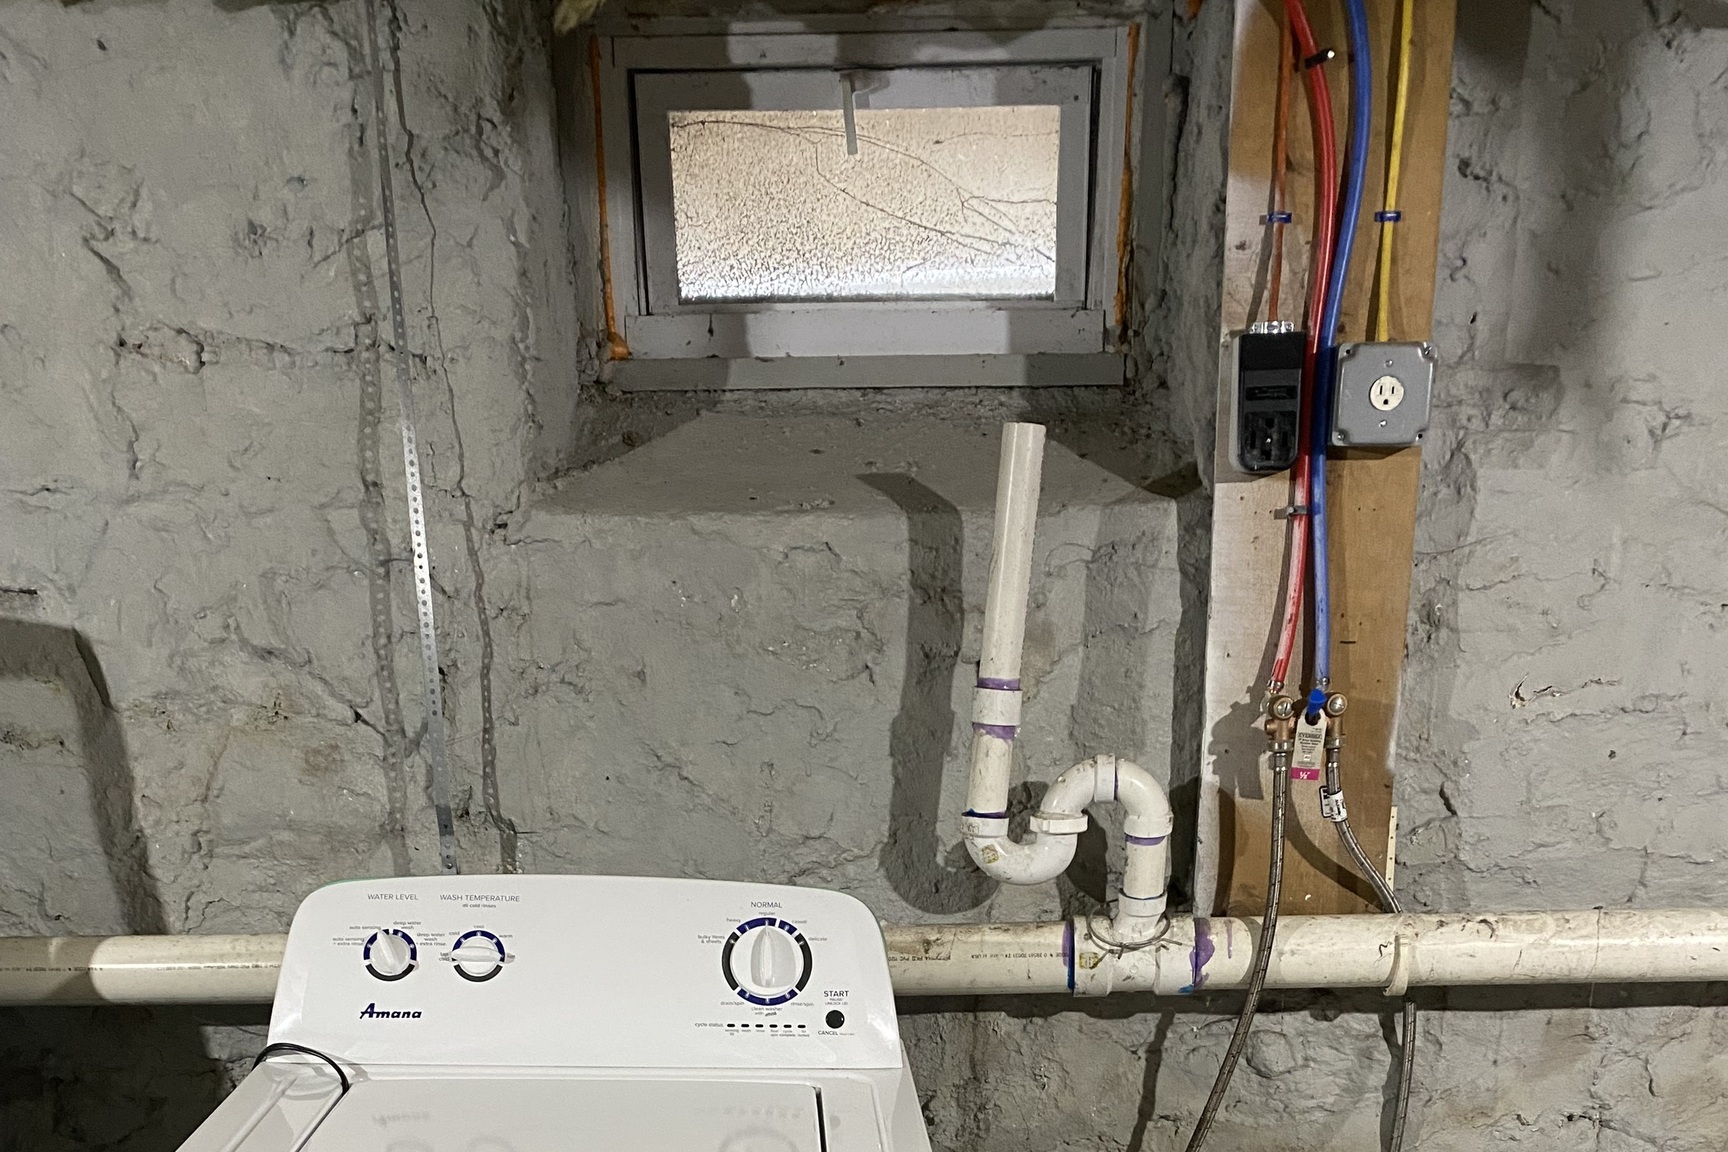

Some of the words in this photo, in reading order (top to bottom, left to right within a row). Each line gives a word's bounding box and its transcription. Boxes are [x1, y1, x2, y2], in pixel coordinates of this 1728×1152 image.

[367, 893, 394, 901] WATER
[395, 893, 419, 901] LEVEL
[465, 894, 520, 902] TEMPERATURE
[750, 901, 783, 909] NORMAL
[823, 990, 850, 998] START
[359, 1002, 423, 1020] Amana
